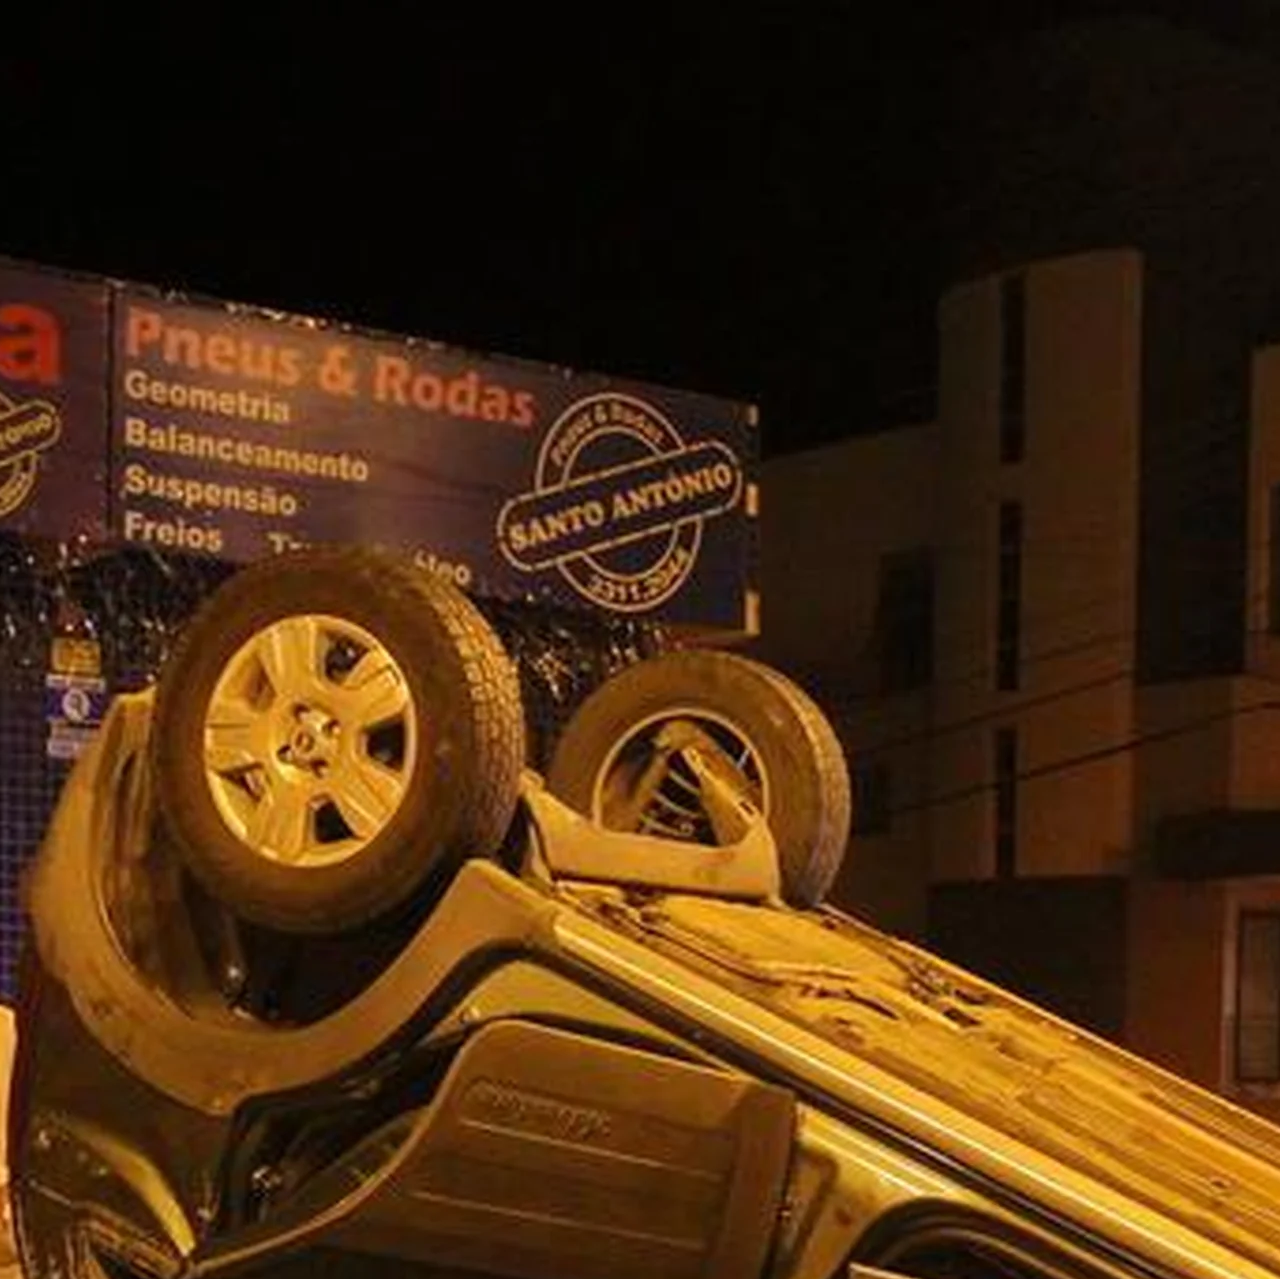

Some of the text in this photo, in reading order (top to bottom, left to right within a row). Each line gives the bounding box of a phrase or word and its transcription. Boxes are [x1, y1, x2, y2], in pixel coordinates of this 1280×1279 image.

[125, 306, 538, 430] Pneus & Rodas
[124, 369, 291, 424] Geometria
[124, 416, 369, 483] Balanceamento
[124, 463, 297, 517] Suspensão
[124, 511, 223, 554] Freios
[508, 501, 605, 550] SANTO
